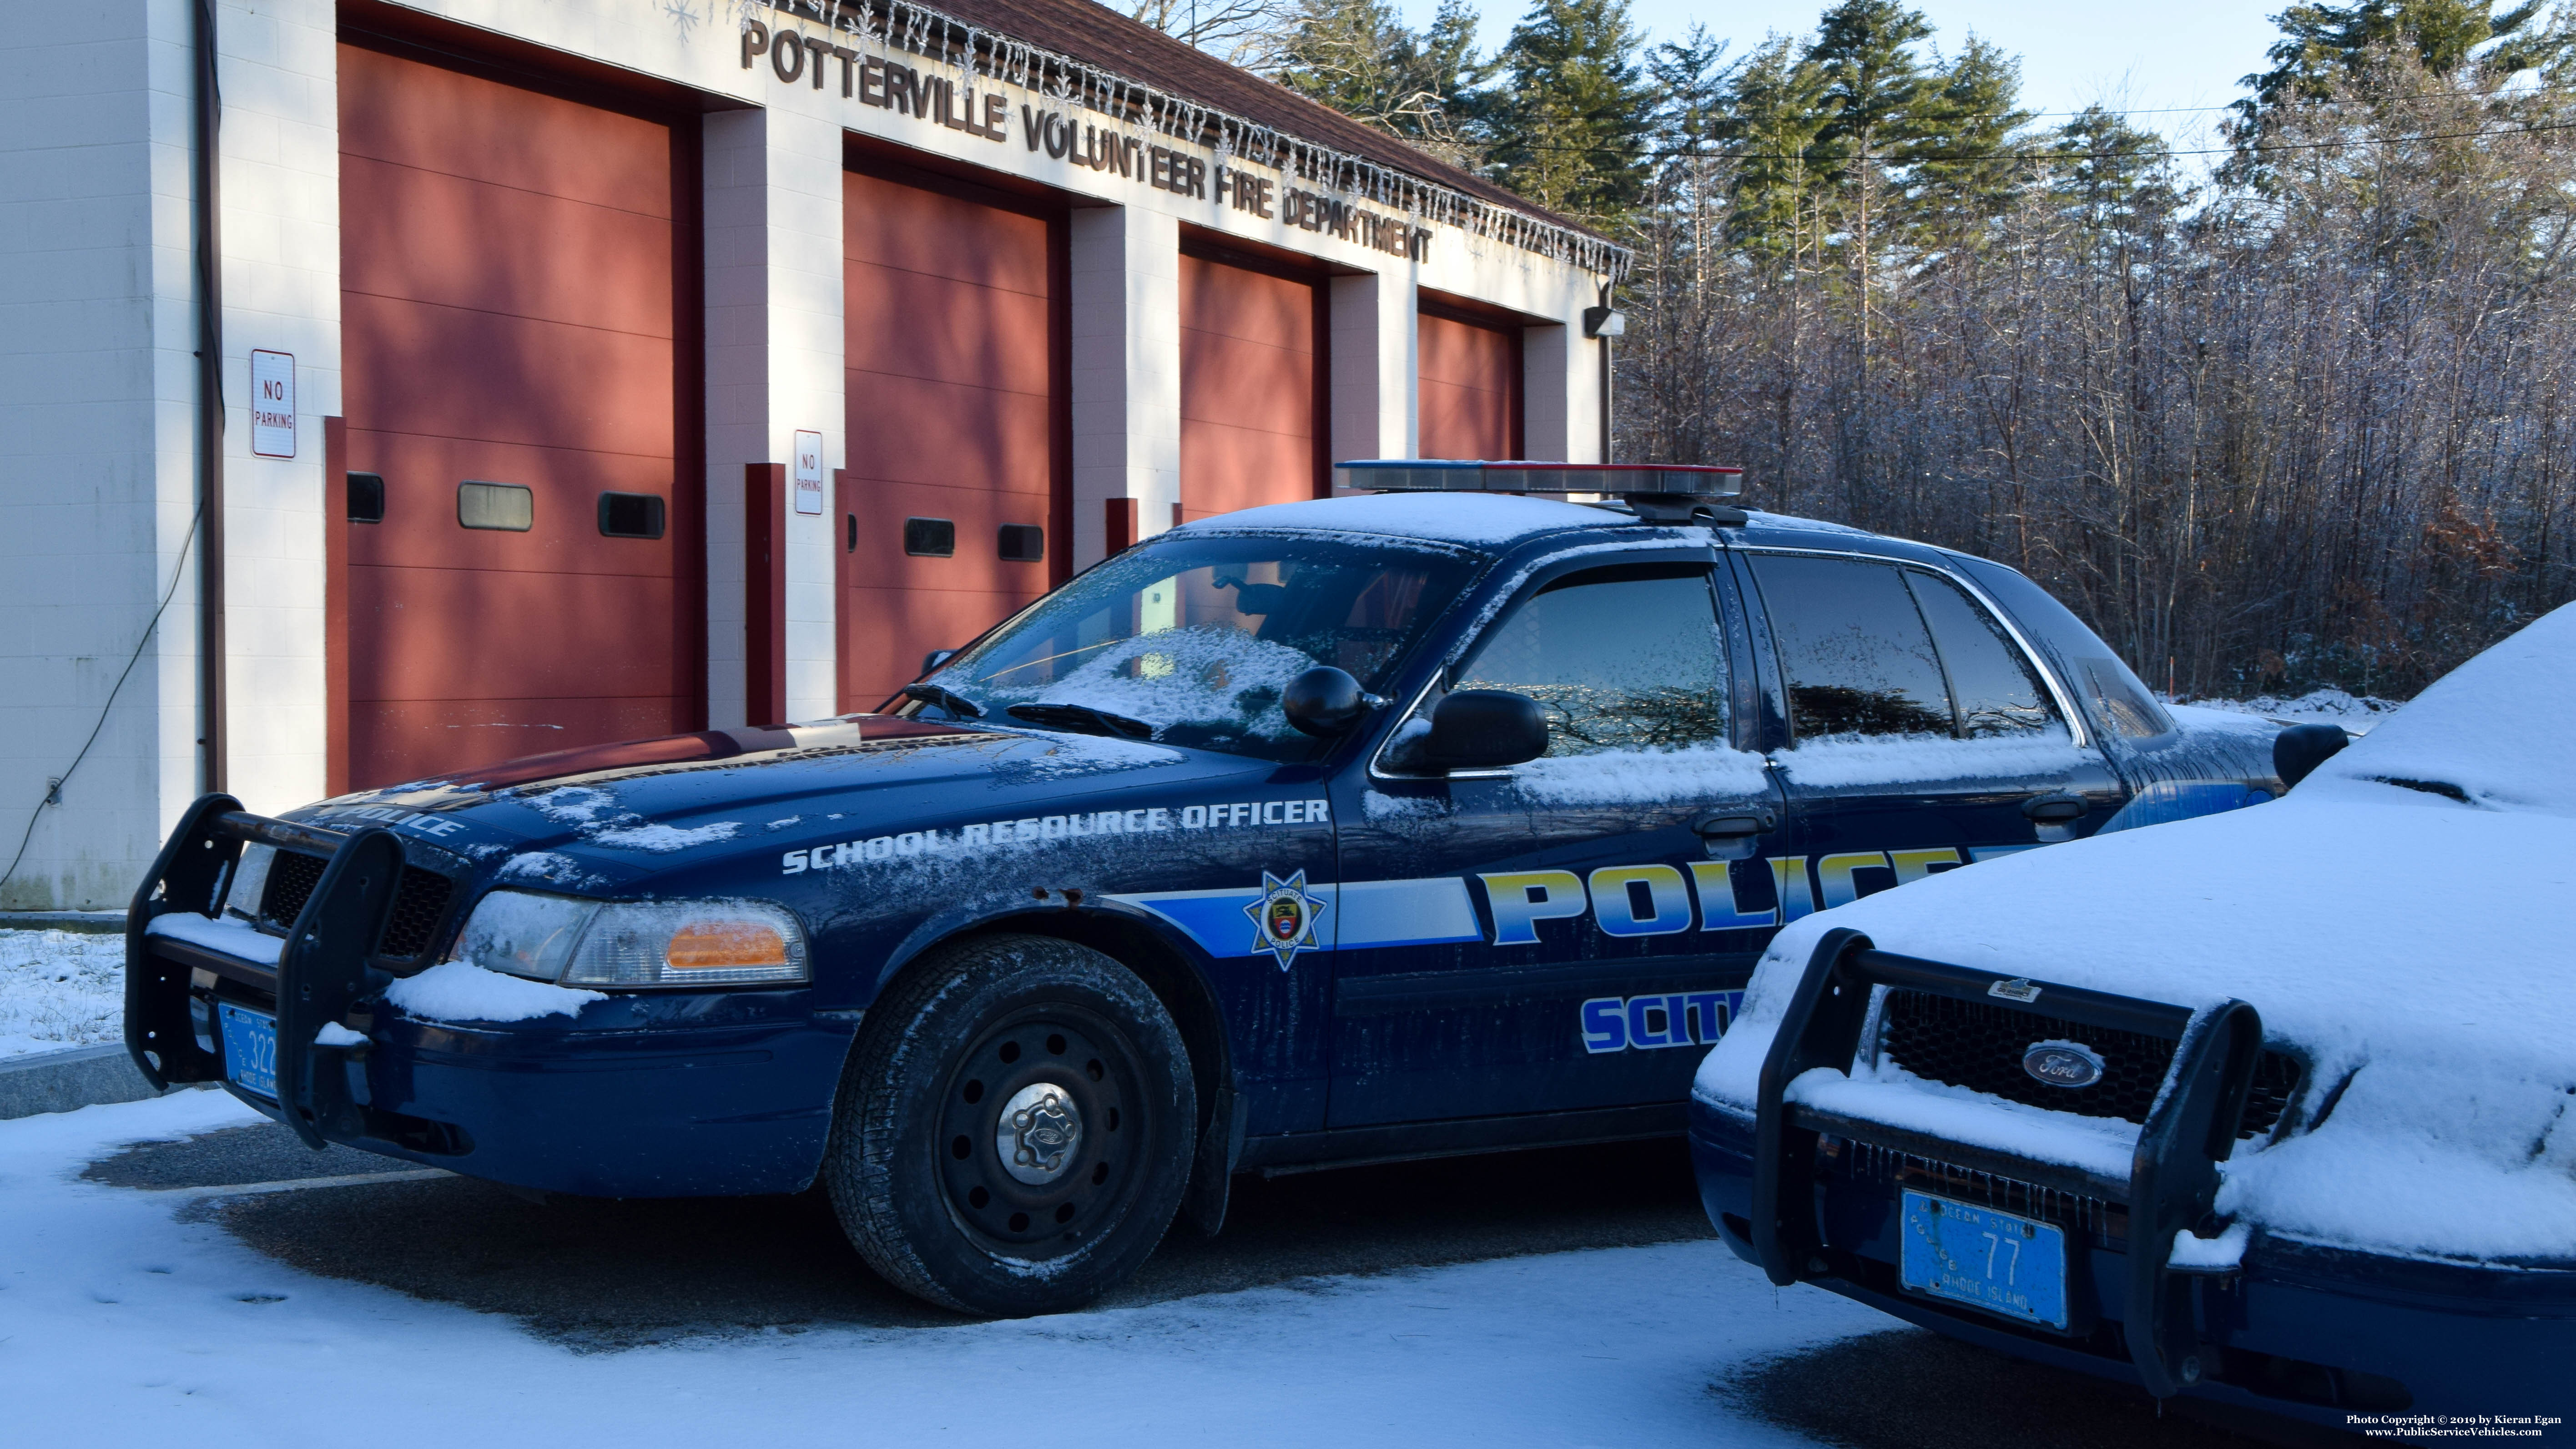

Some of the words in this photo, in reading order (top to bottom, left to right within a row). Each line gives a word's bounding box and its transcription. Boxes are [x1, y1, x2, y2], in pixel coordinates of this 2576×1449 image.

[740, 19, 1008, 142] POTTERVILLE
[1022, 104, 1206, 200] VOLUNTEER
[1215, 165, 1273, 219] FIRE
[1283, 187, 1433, 264] DEPARTMENT
[264, 380, 282, 400] NO
[255, 411, 292, 429] PARKING
[802, 454, 815, 470] NO
[797, 479, 821, 492] PARKING
[336, 807, 465, 837] POLICE
[782, 829, 950, 874] SCHOOL
[963, 808, 1168, 848] RESOURCE
[1182, 799, 1328, 828] OFFICER
[1267, 889, 1302, 904] SCITUATE
[1270, 936, 1300, 948] POLICE
[2039, 1055, 2081, 1078] Ford
[1940, 1204, 1980, 1224] OCEAN
[1982, 1231, 2020, 1286] 77
[1942, 1273, 1981, 1296] RHODE
[1988, 1286, 2027, 1310] ISLAND
